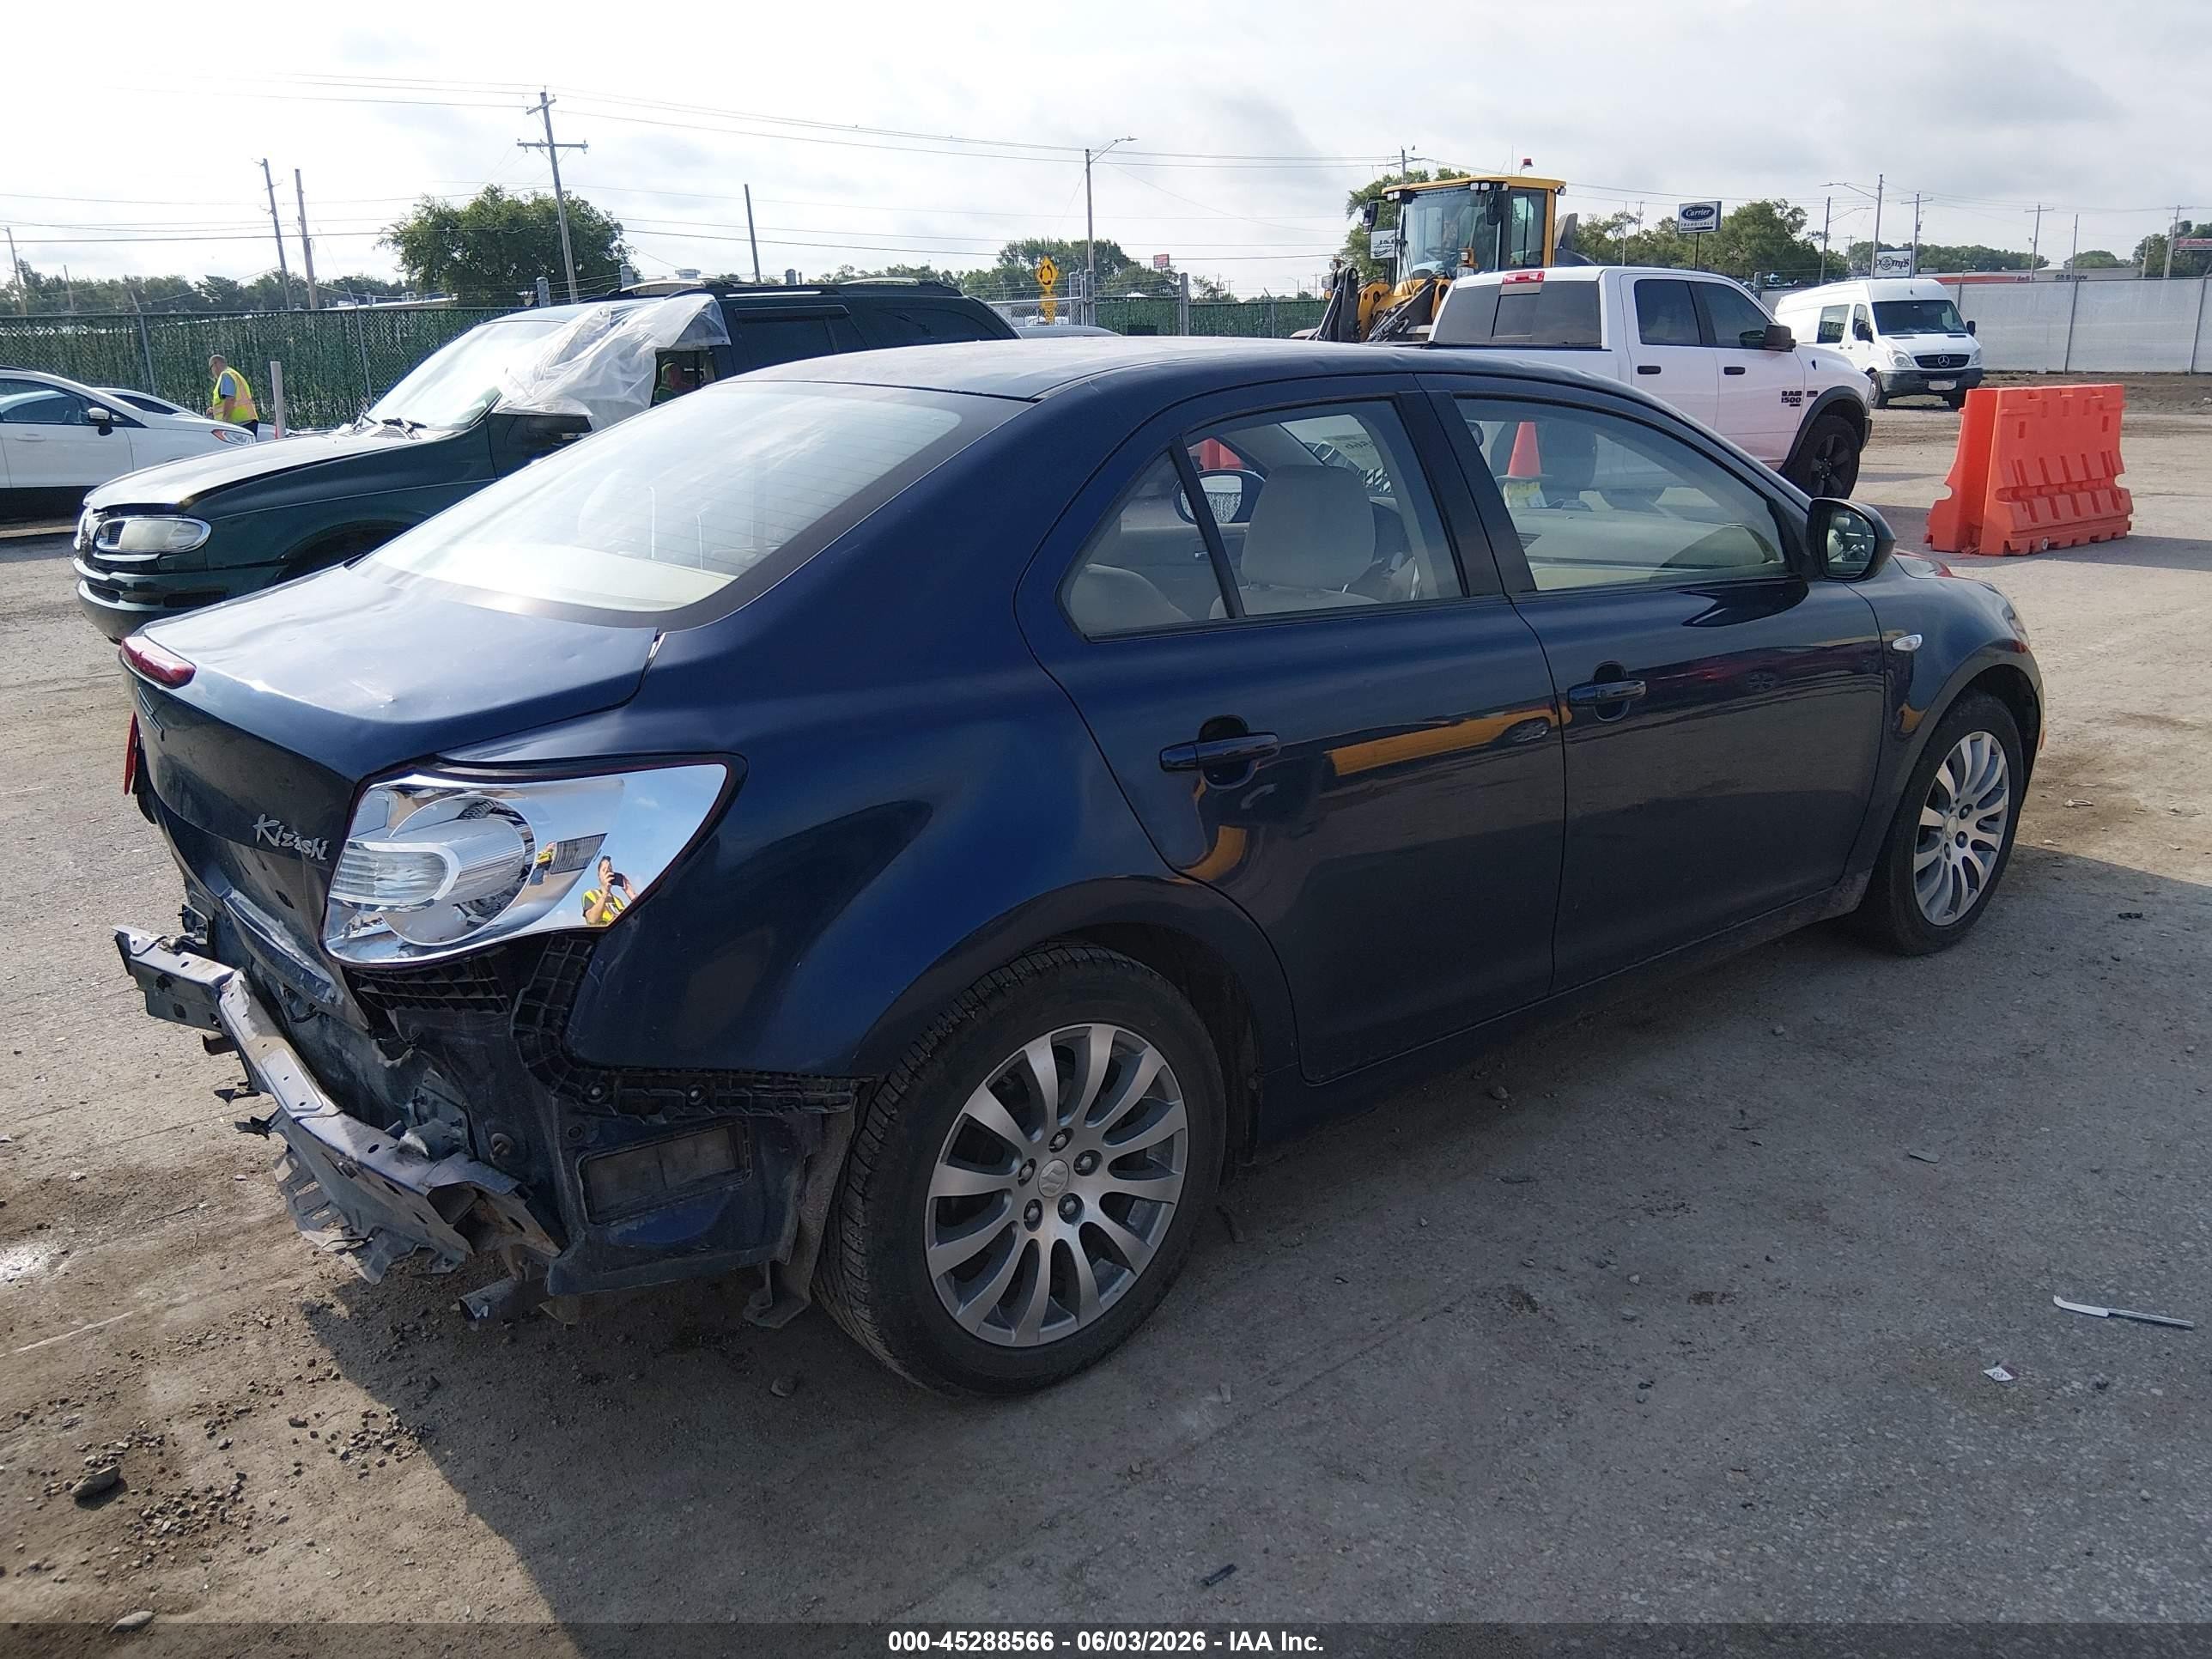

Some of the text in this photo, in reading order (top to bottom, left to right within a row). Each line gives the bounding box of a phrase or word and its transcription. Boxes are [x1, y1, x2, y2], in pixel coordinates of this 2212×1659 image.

[1686, 209, 1711, 217] Carrier
[1383, 317, 1398, 333] WALK
[252, 813, 330, 860] Kizashi
